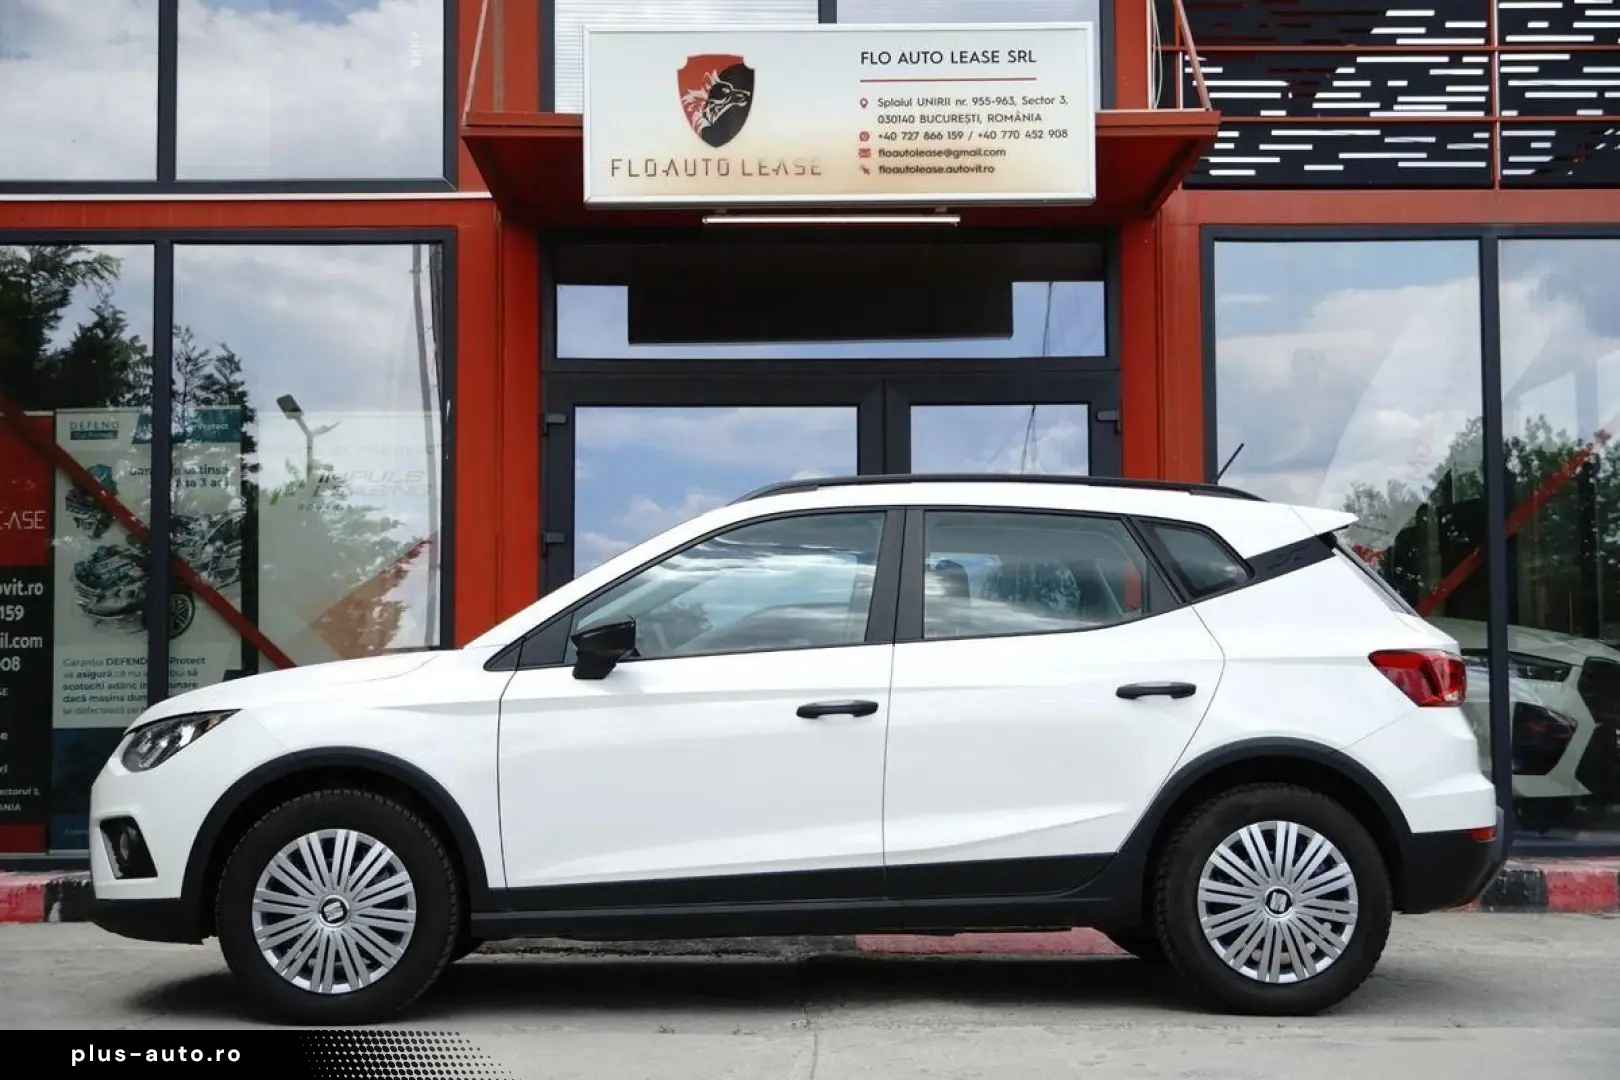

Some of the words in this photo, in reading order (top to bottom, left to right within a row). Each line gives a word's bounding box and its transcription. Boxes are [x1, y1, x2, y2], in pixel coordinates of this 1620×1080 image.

[860, 51, 892, 65] FLO
[897, 51, 943, 65] AUTO
[951, 50, 1000, 64] LEASE
[1007, 50, 1037, 63] SRL
[877, 97, 913, 109] Splaiul
[917, 97, 951, 107] UNIRII
[955, 98, 968, 107] nr.
[971, 96, 1017, 107] 955-963,
[1021, 96, 1056, 106] Sector
[1059, 95, 1069, 106] 3,
[877, 114, 915, 124] 030140
[987, 111, 1043, 123] ROMÂNIA
[878, 131, 897, 141] +40
[902, 131, 920, 141] 727
[923, 131, 943, 141] 866
[947, 131, 964, 141] 159
[978, 130, 997, 140] +40
[1001, 130, 1020, 140] 770
[1024, 129, 1044, 139] 452
[1048, 129, 1069, 139] 908
[878, 148, 1006, 160] floautolease@gmail.com
[741, 157, 823, 177] LEASE
[878, 164, 995, 175] floautolease.autovit.ro
[69, 421, 120, 430] DEFEND
[0, 510, 47, 530] ASE
[169, 682, 198, 690] unare
